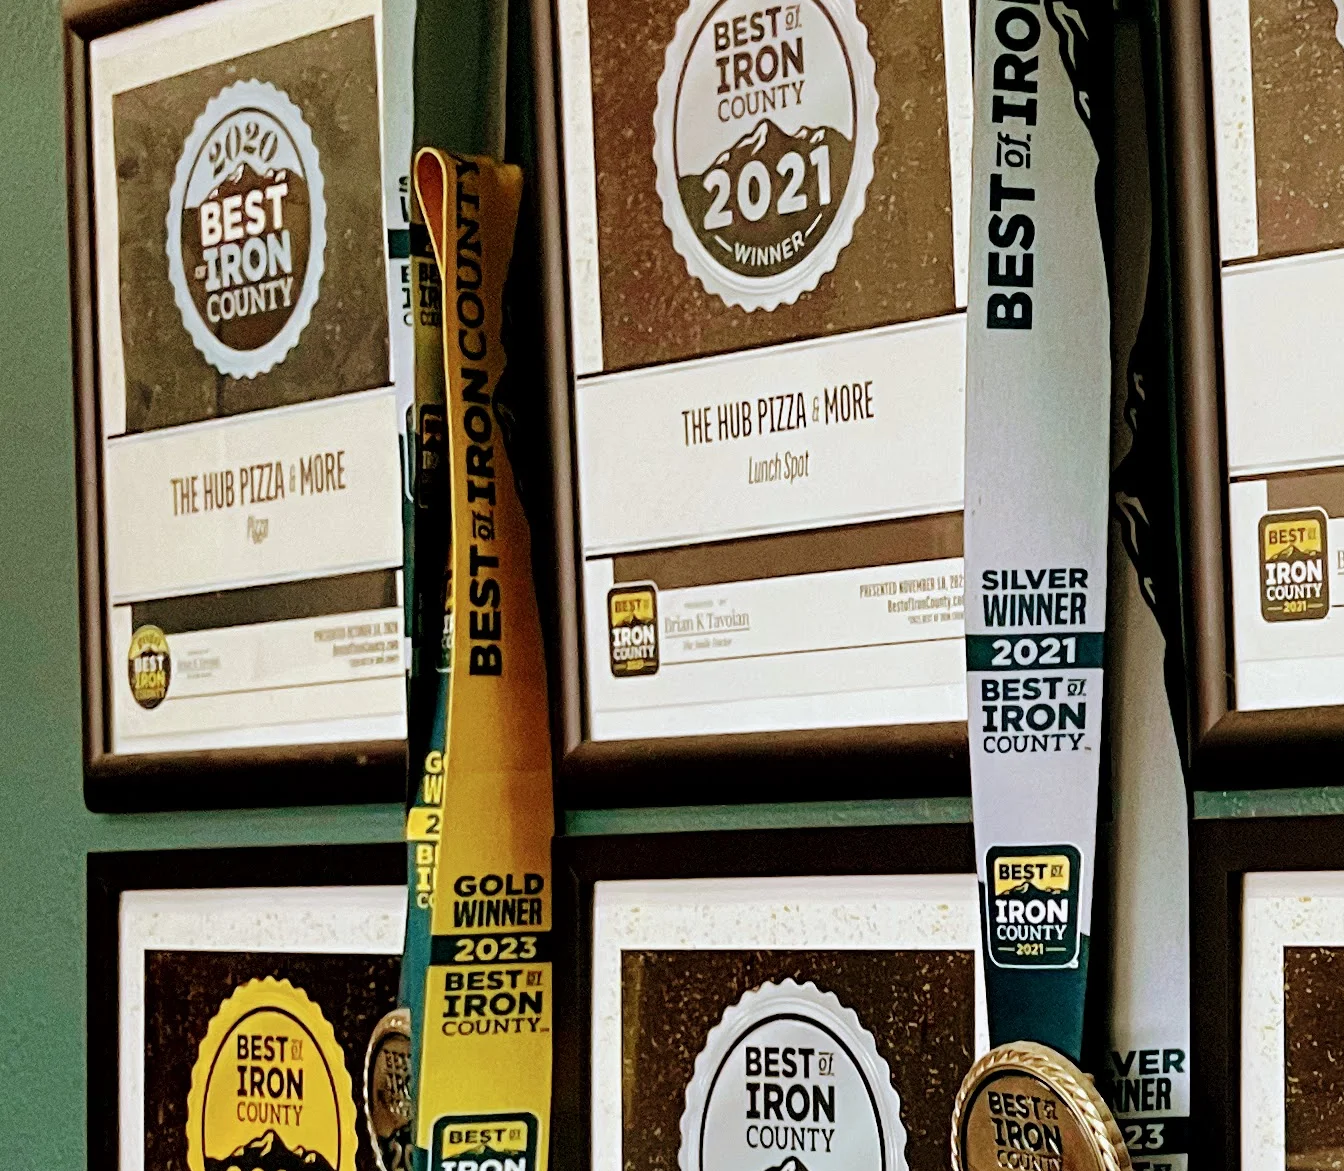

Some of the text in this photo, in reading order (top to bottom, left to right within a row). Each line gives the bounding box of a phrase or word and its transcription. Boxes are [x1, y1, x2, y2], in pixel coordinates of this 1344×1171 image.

[208, 121, 278, 176] 2020
[703, 145, 832, 230] 2021
[200, 181, 289, 247] BEST
[204, 230, 293, 292] IRON
[456, 156, 487, 361] COUNTY
[682, 408, 712, 446] THE
[718, 402, 752, 440] HUB
[757, 392, 807, 435] PIZZA
[824, 381, 875, 425] MORE
[460, 367, 496, 506] IRON
[748, 450, 809, 485] Lunch Spot
[1269, 528, 1306, 545] BEST
[982, 567, 1089, 590] SILVER
[1265, 560, 1323, 585] IRON
[1267, 583, 1322, 601] COUNTY
[469, 545, 502, 676] BEST
[983, 592, 1086, 627] WINNER
[991, 637, 1077, 667] 2021
[982, 702, 1086, 733] IRON
[453, 874, 544, 898] GOLD
[453, 899, 542, 928] WINNER
[996, 900, 1068, 924] IRON
[997, 924, 1067, 942] COUNTY
[454, 937, 537, 962] 2023
[445, 970, 523, 991] BEST
[442, 991, 542, 1018] IRON
[237, 1034, 288, 1060] BEST
[237, 1102, 303, 1126] COUNTY
[988, 1092, 1040, 1119] BEST
[449, 1129, 506, 1145] BEST
[746, 1125, 835, 1152] COUNTY
